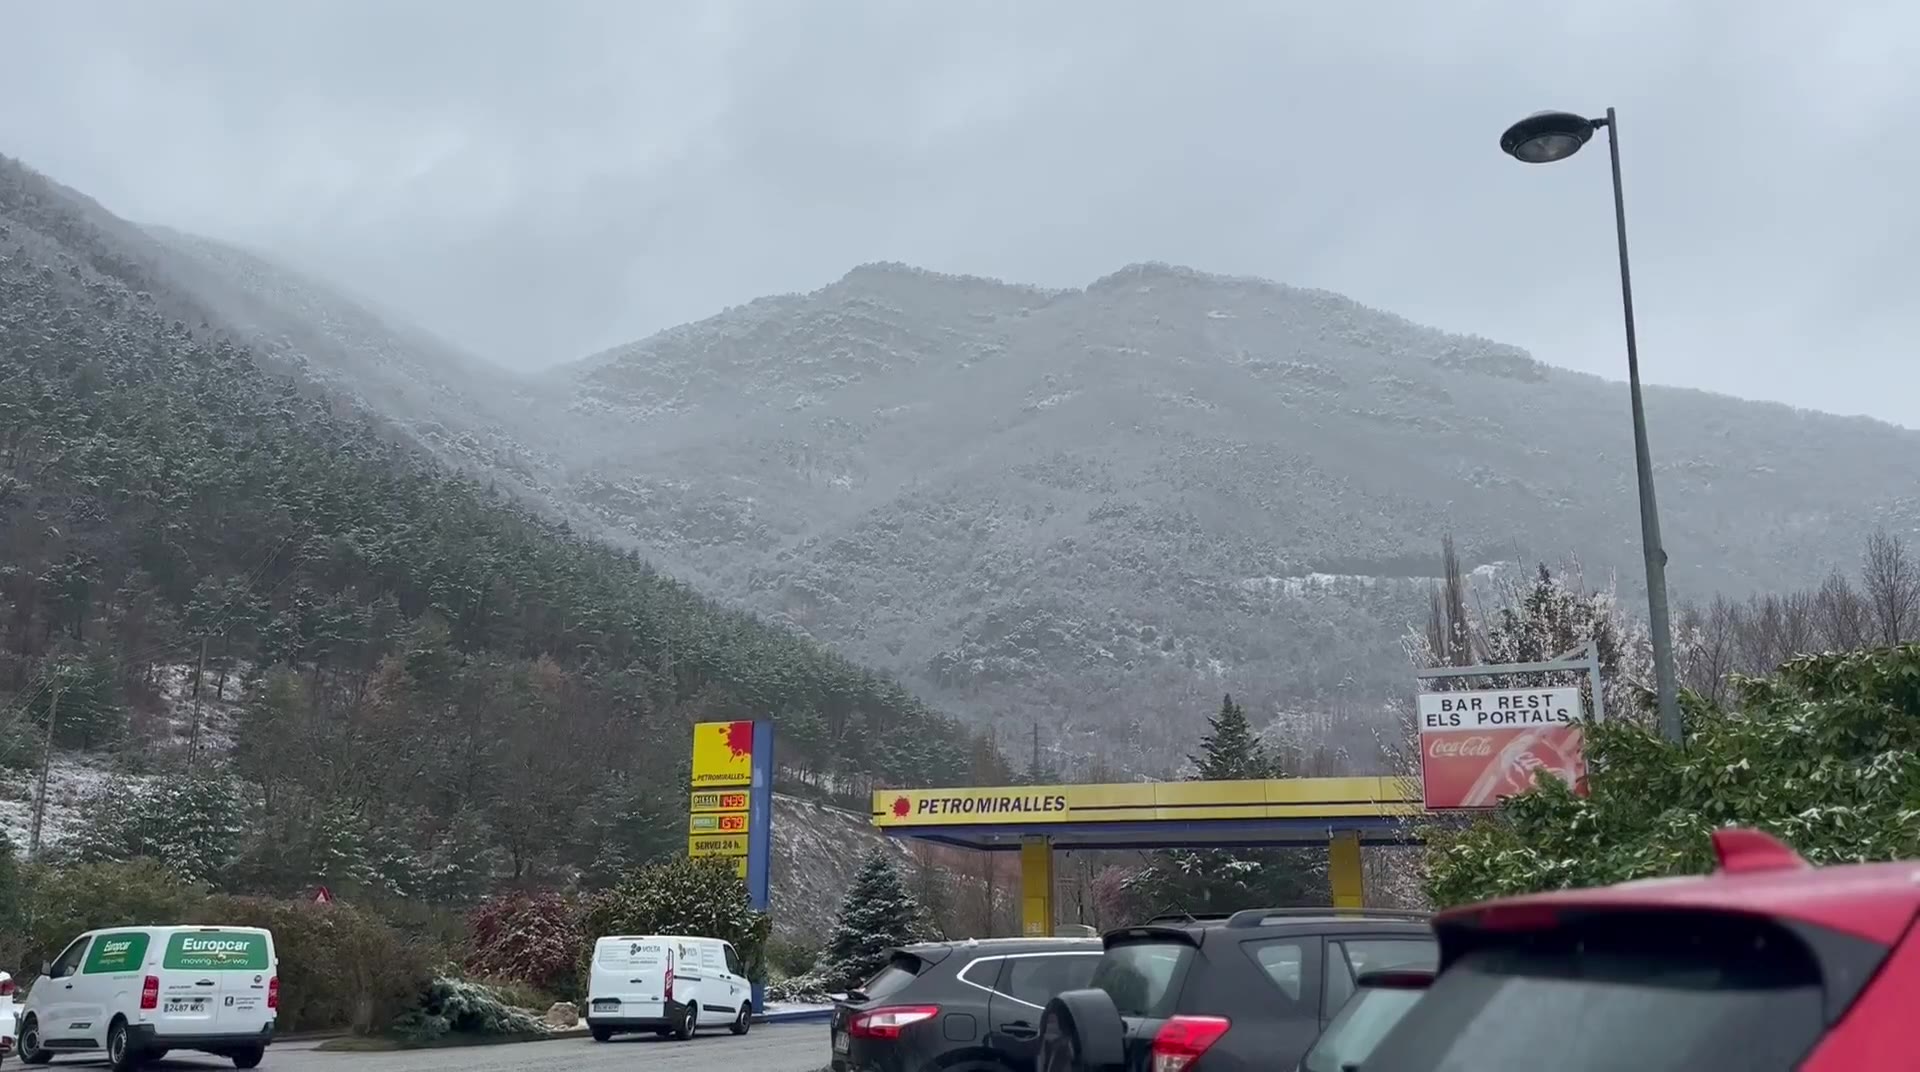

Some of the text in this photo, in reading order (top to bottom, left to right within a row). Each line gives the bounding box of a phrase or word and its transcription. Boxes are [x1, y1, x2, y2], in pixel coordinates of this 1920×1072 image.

[1441, 694, 1554, 712] BAR REST
[1427, 709, 1568, 727] ELS PORTALS
[697, 773, 745, 781] PETROMIRALLES
[917, 796, 1065, 814] PETROMIRALLES
[695, 841, 721, 850] SERVEI
[722, 840, 732, 849] 24
[103, 940, 131, 952] Europcar
[182, 938, 250, 954] Europcar
[181, 958, 212, 966] moving
[232, 958, 249, 966] way
